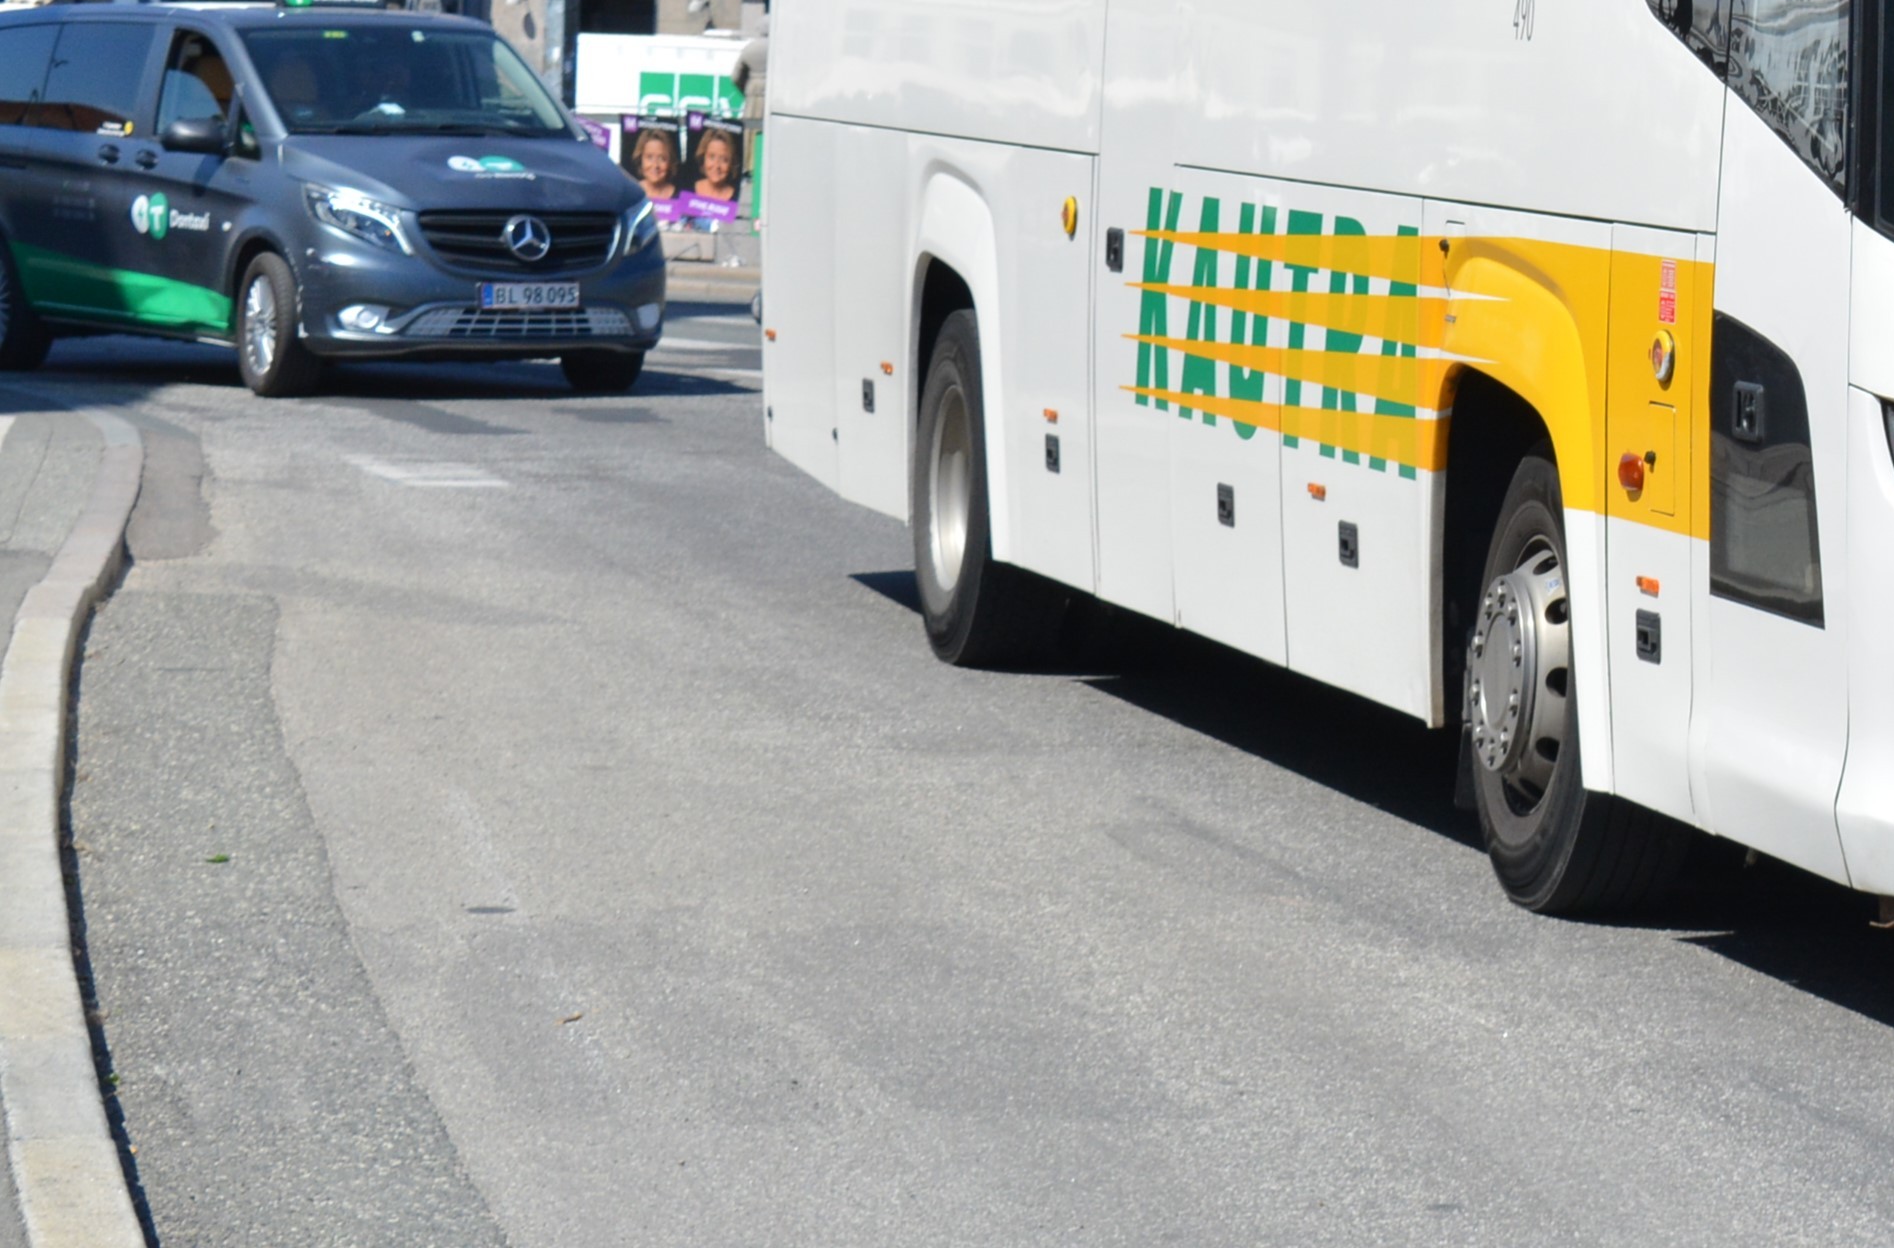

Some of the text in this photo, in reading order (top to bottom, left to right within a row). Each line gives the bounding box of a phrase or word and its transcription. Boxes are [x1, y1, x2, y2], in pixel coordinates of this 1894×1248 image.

[495, 287, 577, 304] BL 98 095
[1135, 186, 1419, 481] KAUTRA
